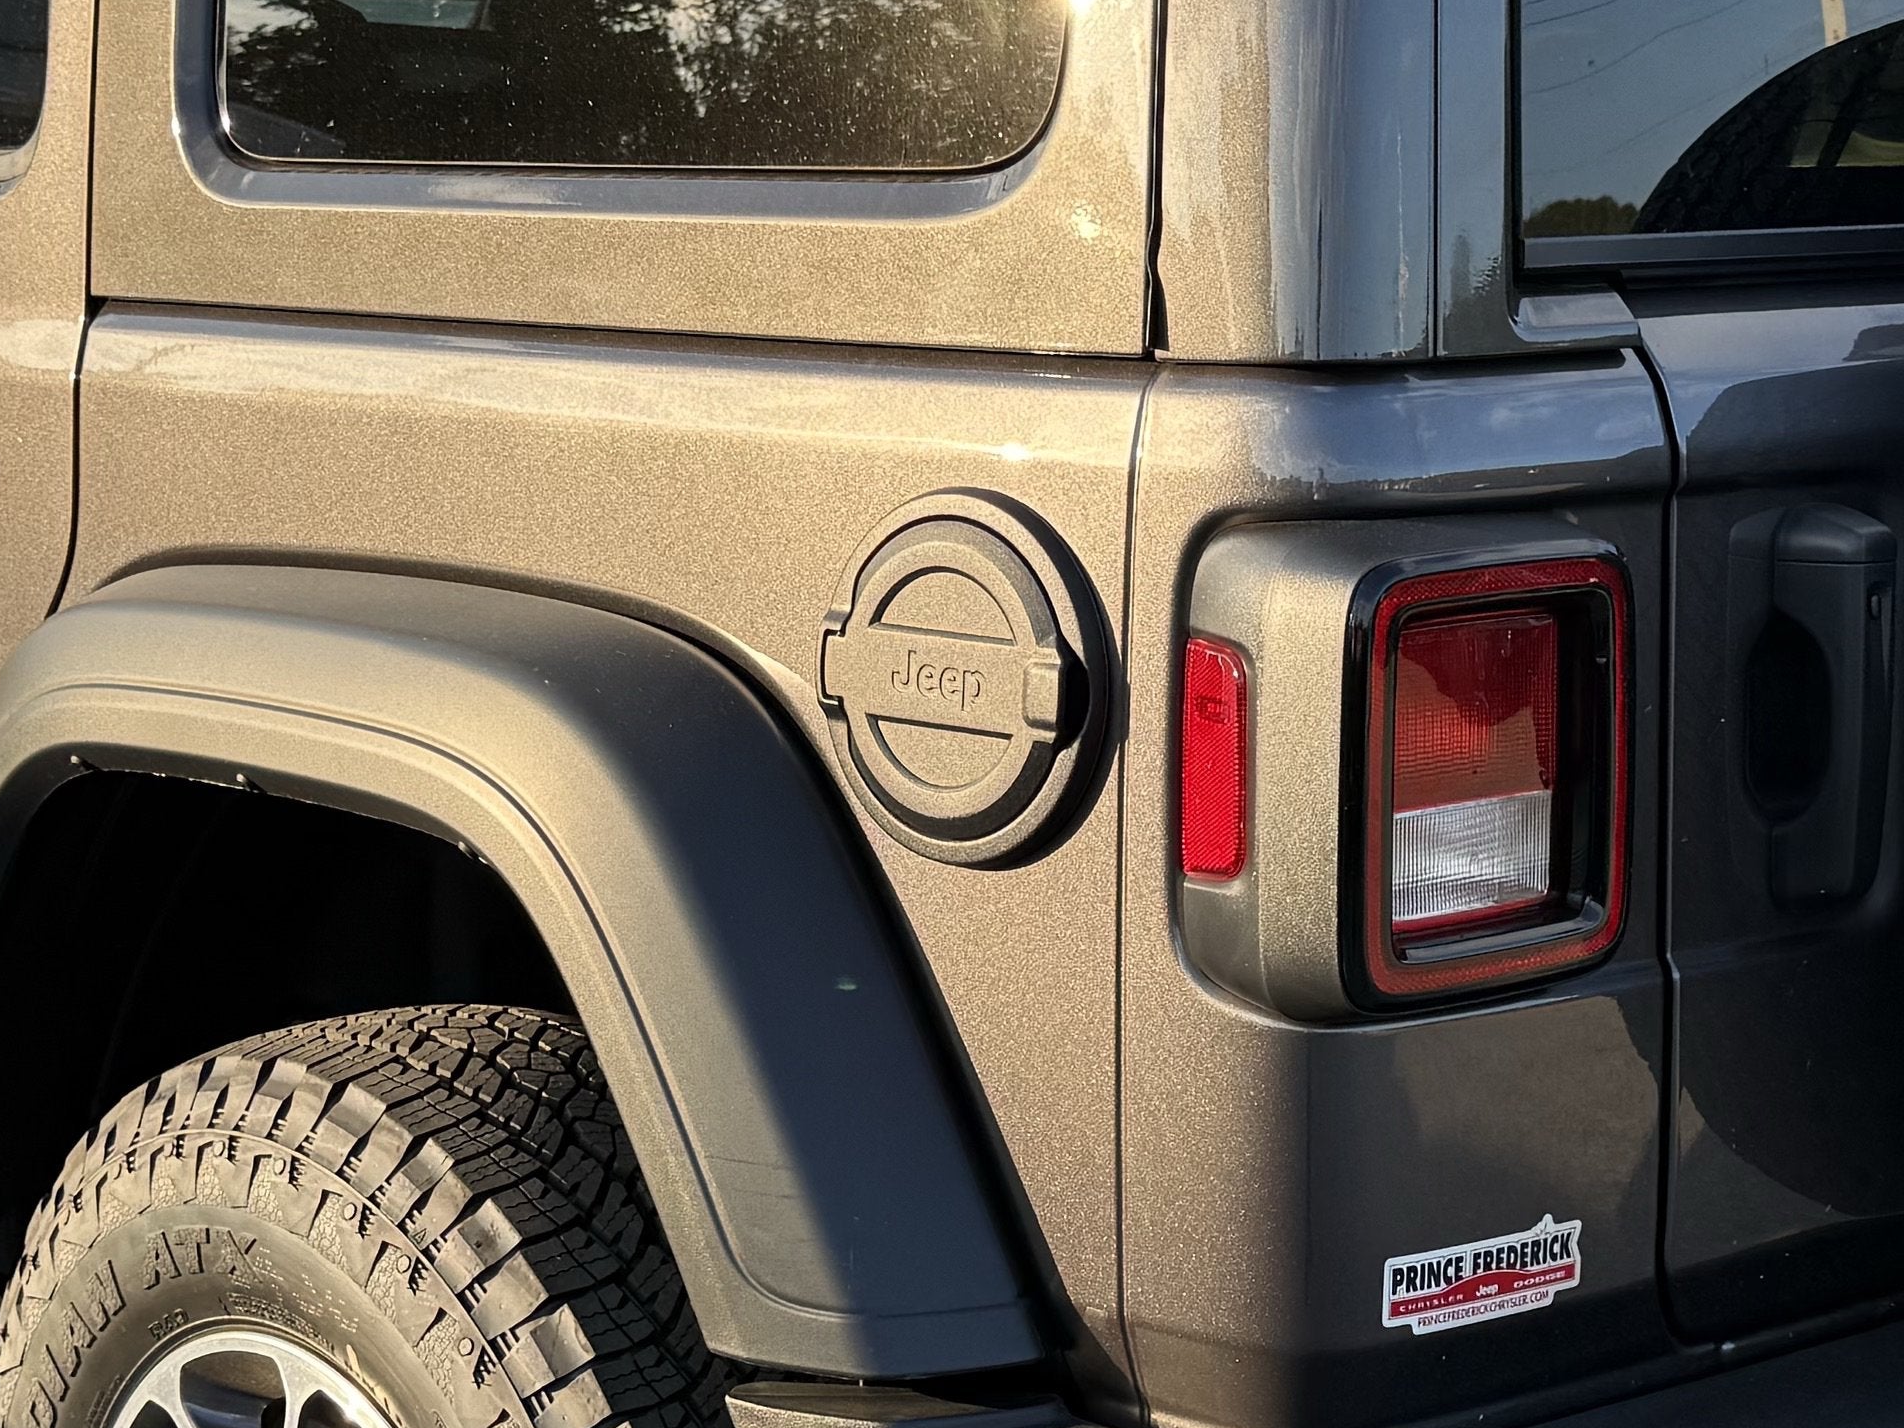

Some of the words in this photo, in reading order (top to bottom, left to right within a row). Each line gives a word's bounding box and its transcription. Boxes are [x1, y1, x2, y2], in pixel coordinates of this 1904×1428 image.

[891, 649, 986, 713] Jeep
[142, 1226, 266, 1291] ATX
[1392, 1255, 1464, 1295] PRINCE
[1472, 1231, 1573, 1275] FREDERICK
[1475, 1283, 1499, 1298] Jeep
